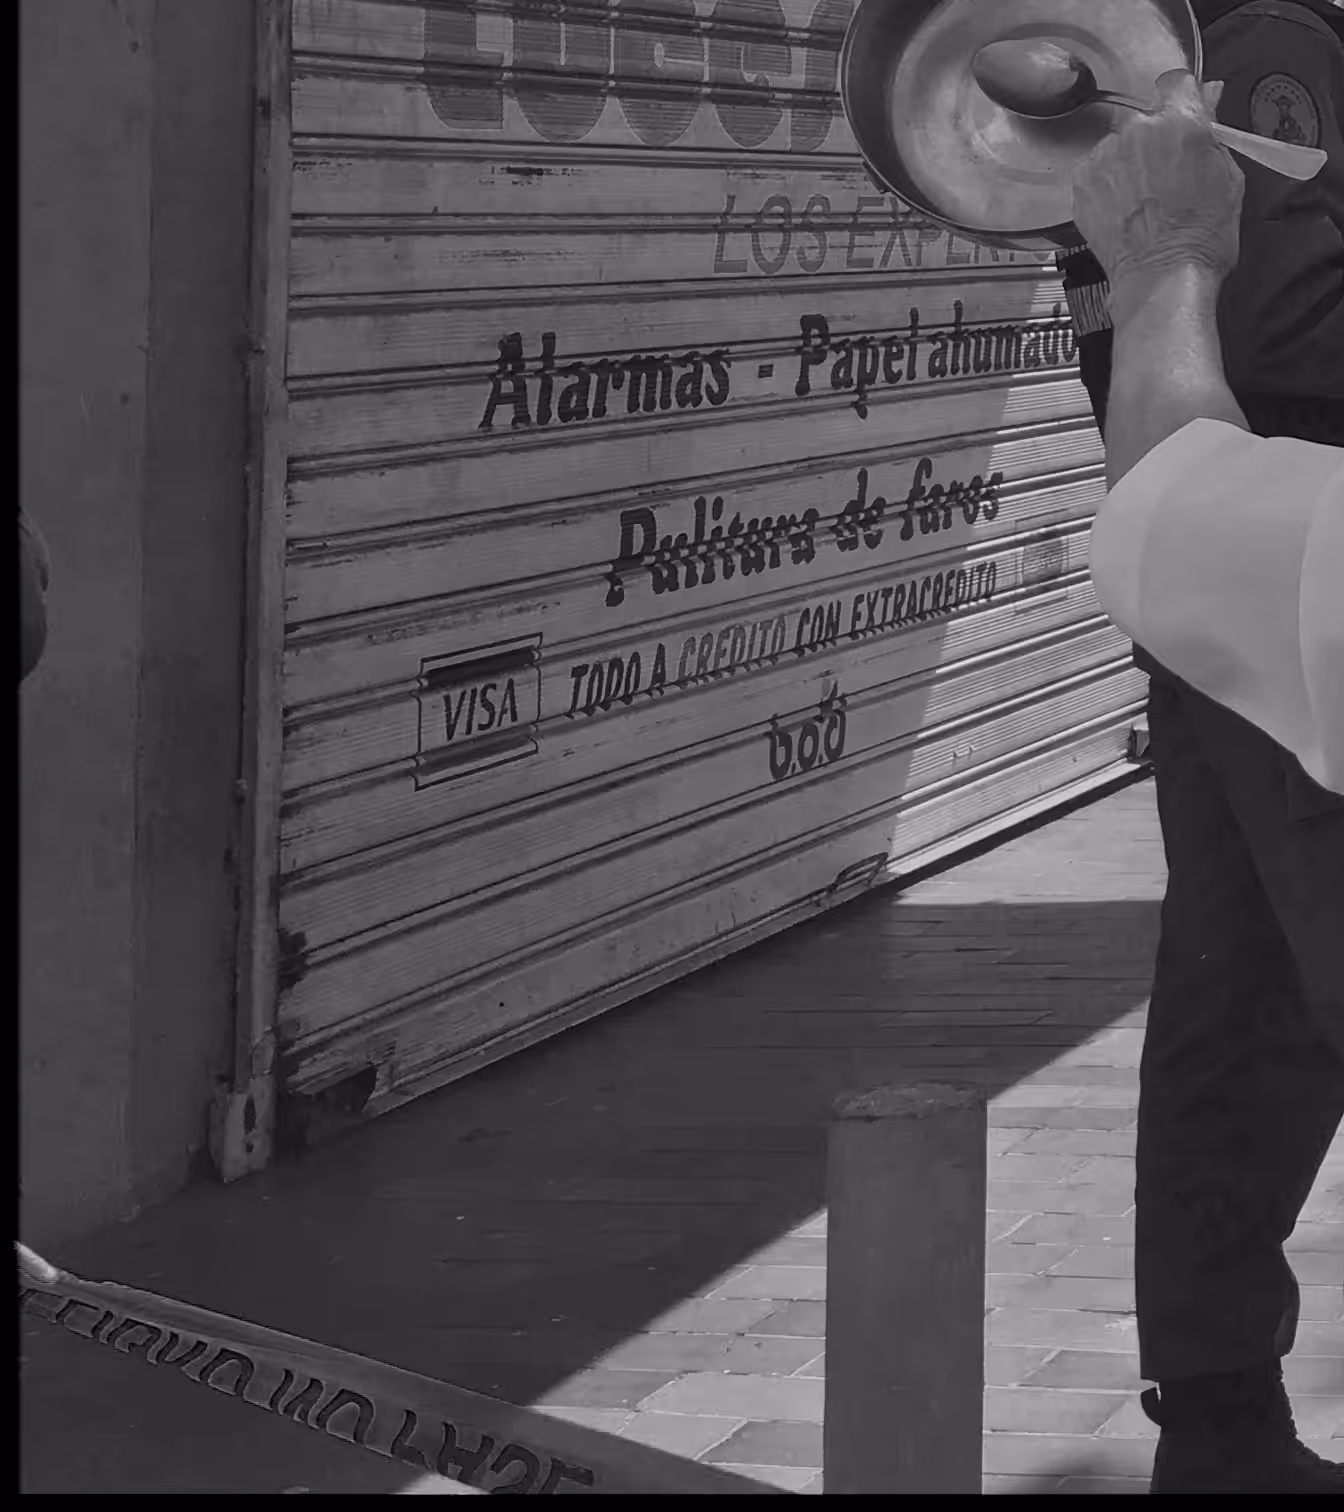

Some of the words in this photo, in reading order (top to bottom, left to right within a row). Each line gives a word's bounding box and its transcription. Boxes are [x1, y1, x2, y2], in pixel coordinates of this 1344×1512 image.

[713, 193, 833, 275] LOS
[478, 331, 731, 430] Alarmas
[795, 300, 920, 418] Papel
[926, 299, 1079, 379] ahumado
[605, 496, 820, 607] Pulitura
[831, 468, 887, 552] de
[899, 458, 1004, 542] faros
[562, 652, 642, 719] TODO
[646, 642, 667, 695] A
[677, 612, 787, 686] CREDITO
[796, 598, 842, 655] CON
[850, 559, 998, 641] EXTRACREDITO
[441, 678, 520, 742] VISA
